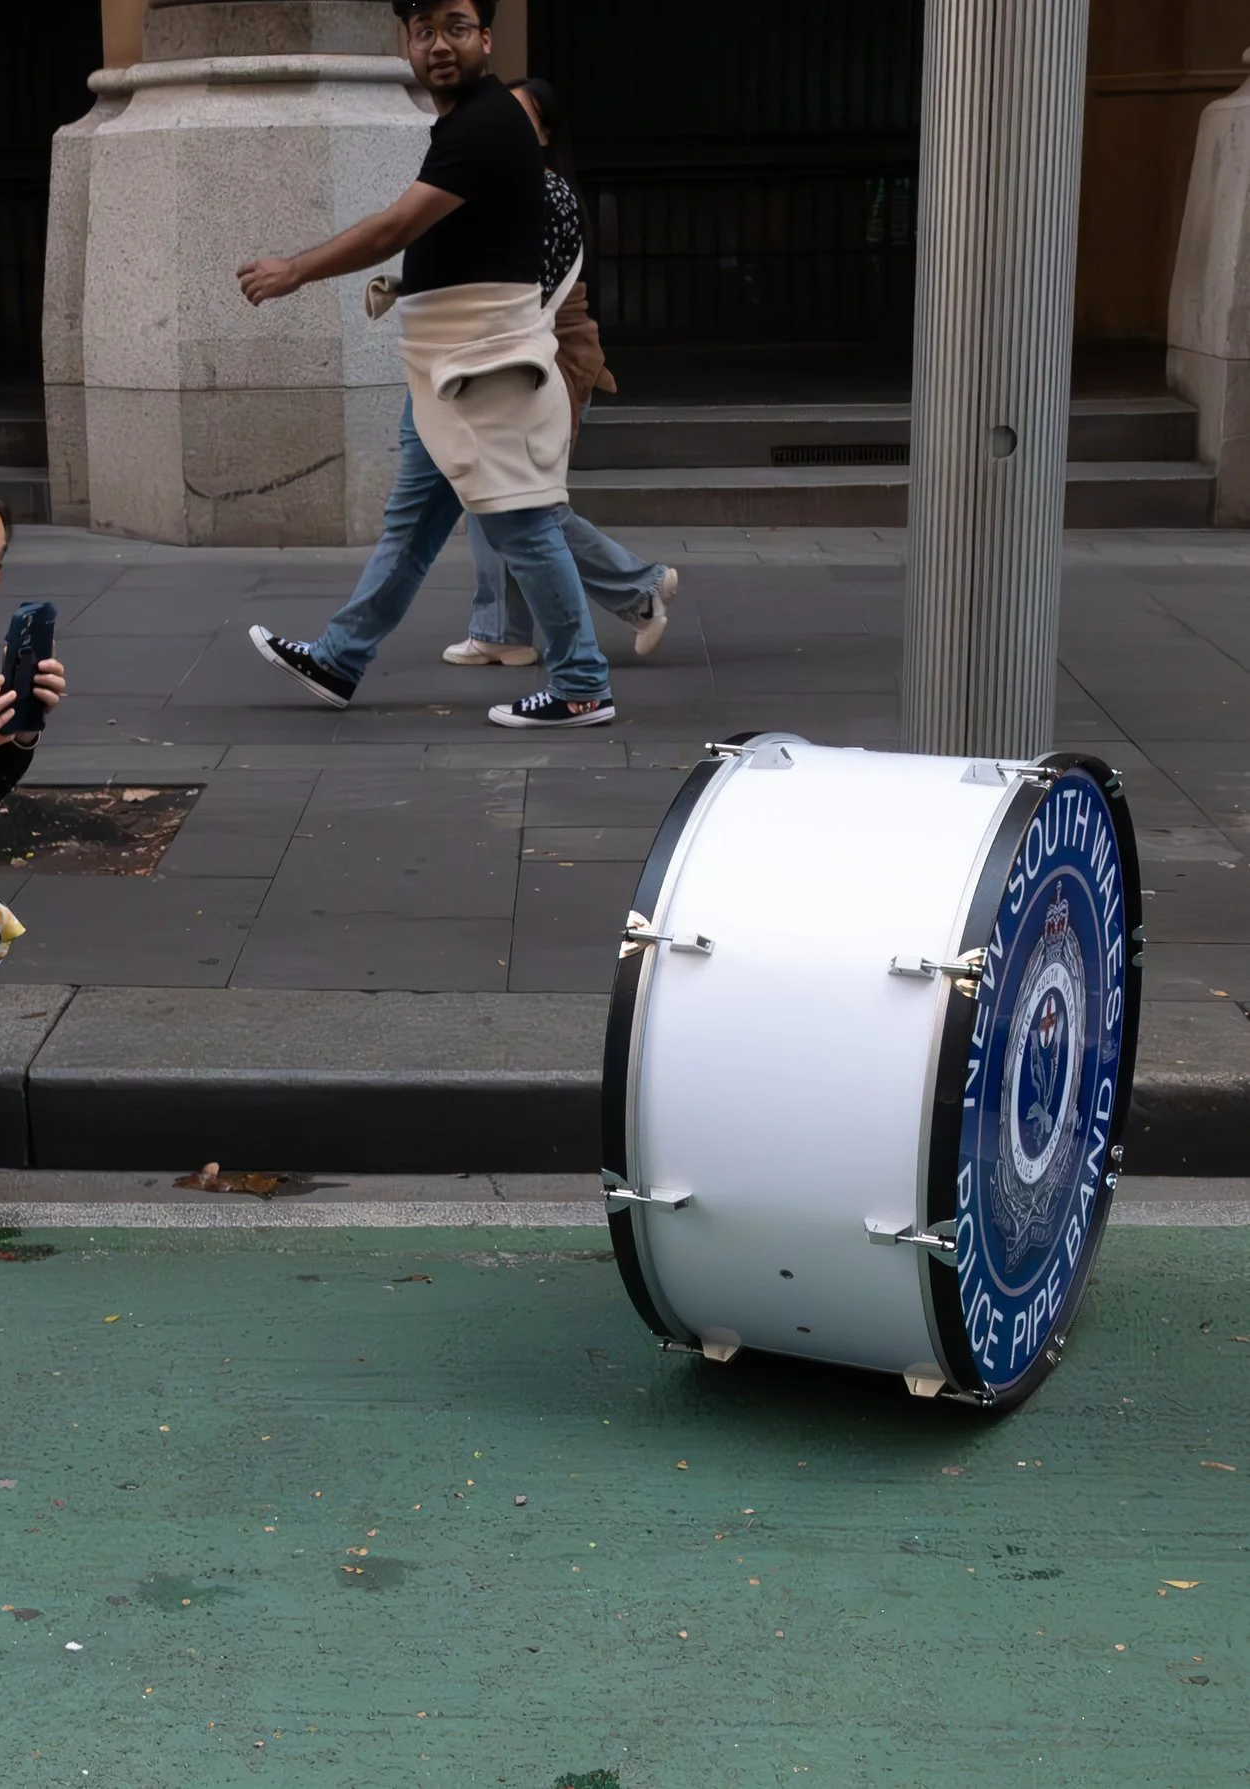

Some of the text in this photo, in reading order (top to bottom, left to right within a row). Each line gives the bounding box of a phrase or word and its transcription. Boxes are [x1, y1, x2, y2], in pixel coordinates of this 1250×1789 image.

[963, 789, 1123, 1108] NEW SOUTH WALES
[1037, 967, 1059, 999] SOUTH
[956, 1160, 1004, 1370] POLICE
[1009, 1258, 1062, 1369] PIPE
[1065, 1076, 1113, 1269] BAND
[1014, 1116, 1061, 1179] POLICE FORCE
